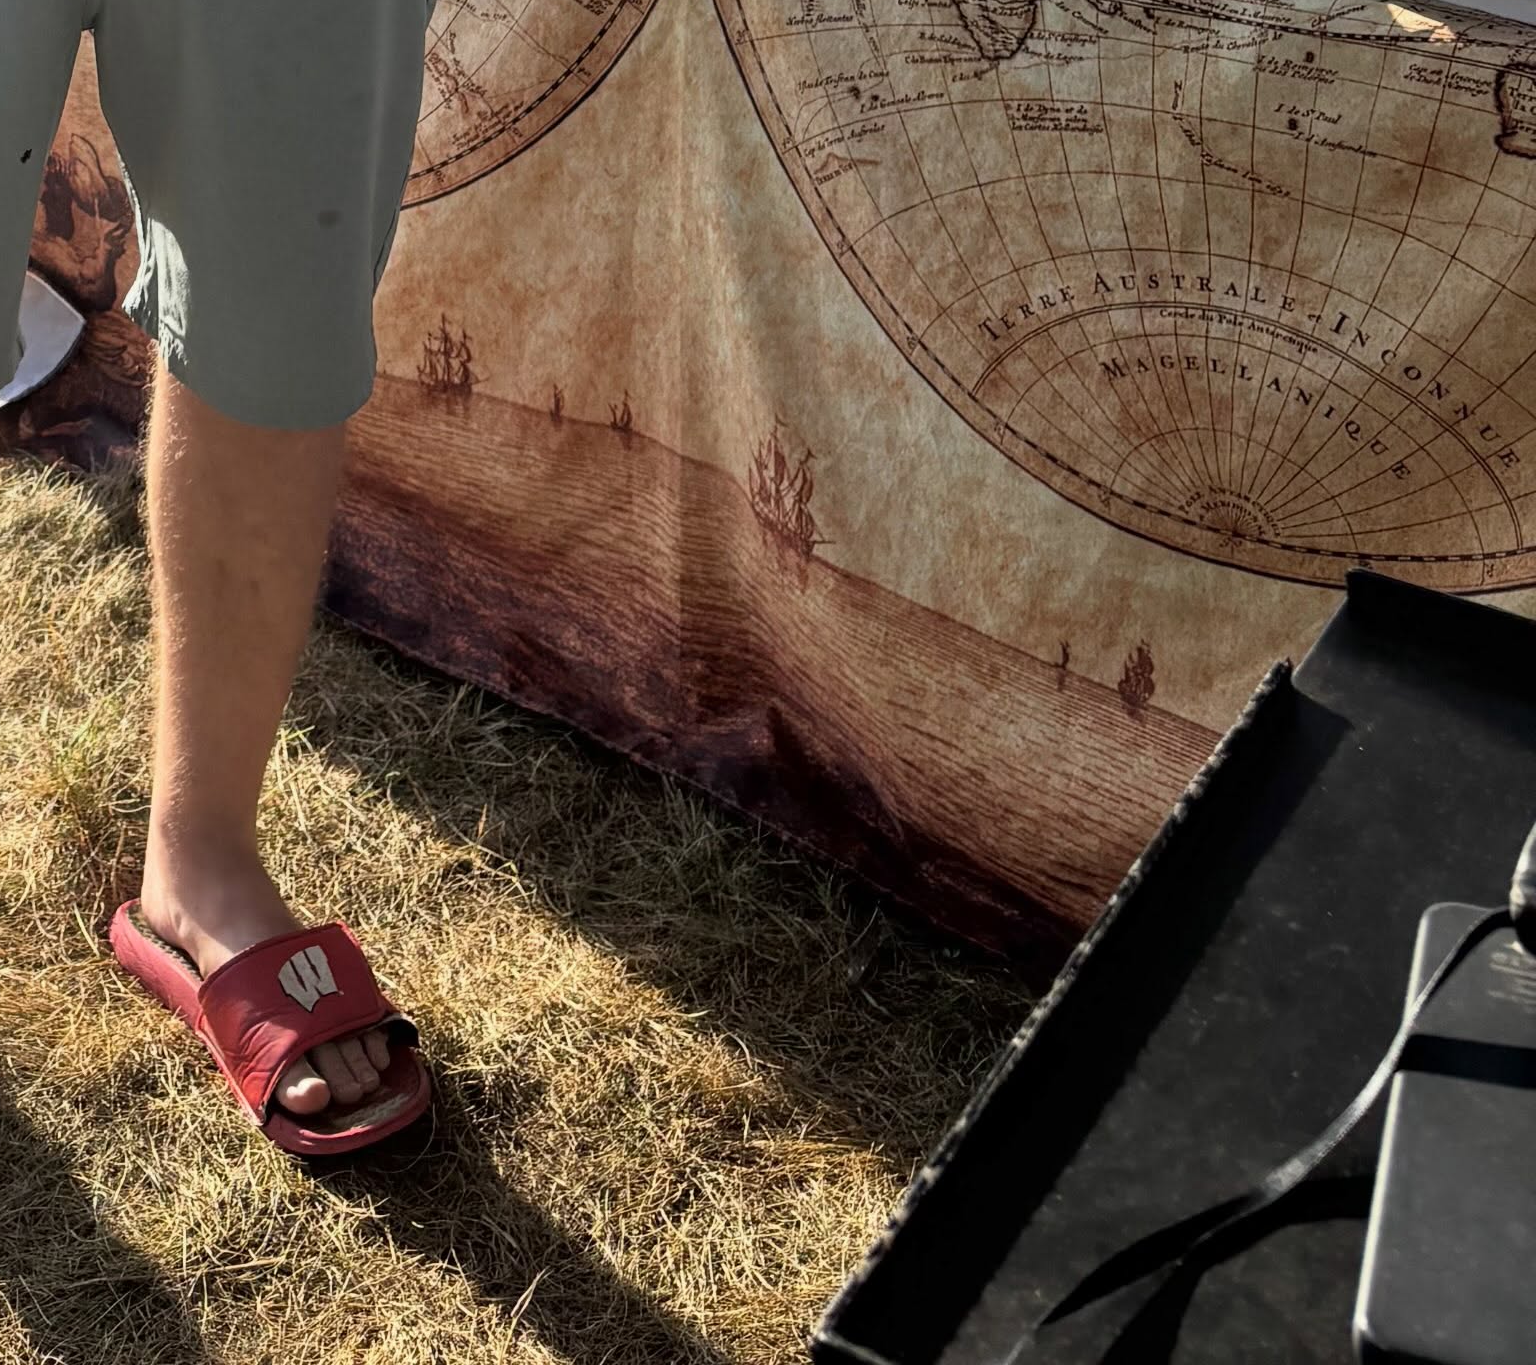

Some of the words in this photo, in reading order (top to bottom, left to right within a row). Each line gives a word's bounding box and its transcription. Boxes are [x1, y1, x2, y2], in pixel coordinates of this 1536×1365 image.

[1287, 106, 1302, 117] de
[1317, 111, 1342, 125] Paul
[1159, 309, 1195, 319] Cercle
[1198, 309, 1214, 322] du
[1218, 314, 1244, 328] Pole
[978, 285, 1076, 343] TERRE
[1091, 271, 1299, 314] AUSTRALE
[1329, 312, 1522, 469] INCONNUE
[1100, 354, 1412, 482] MAGELLANIQUE
[279, 946, 337, 1013] W
